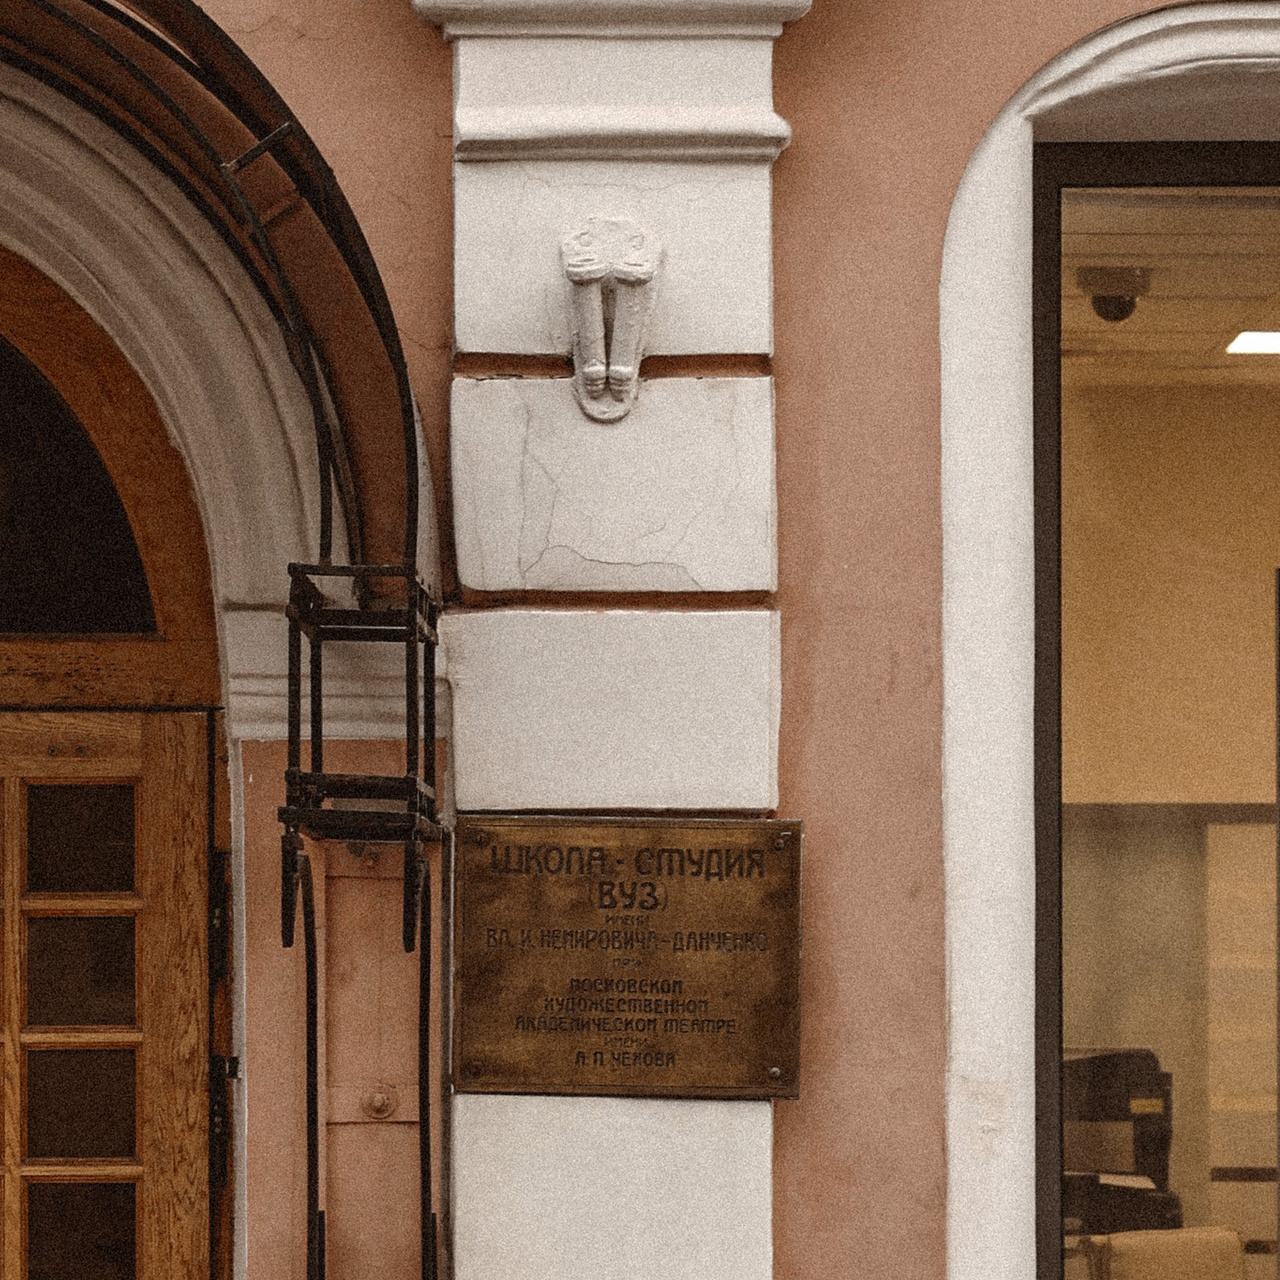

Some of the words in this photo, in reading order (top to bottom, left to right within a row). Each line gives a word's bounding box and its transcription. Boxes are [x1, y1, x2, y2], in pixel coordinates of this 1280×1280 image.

[489, 845, 606, 875] ШКОЛА
[634, 847, 765, 882] СТУДИЯ
[570, 978, 683, 994] МОСКОВСКОМ
[544, 997, 708, 1014] ХУДОЖЕСТВЕННОМ
[664, 1018, 737, 1034] ТЕАТРЕ
